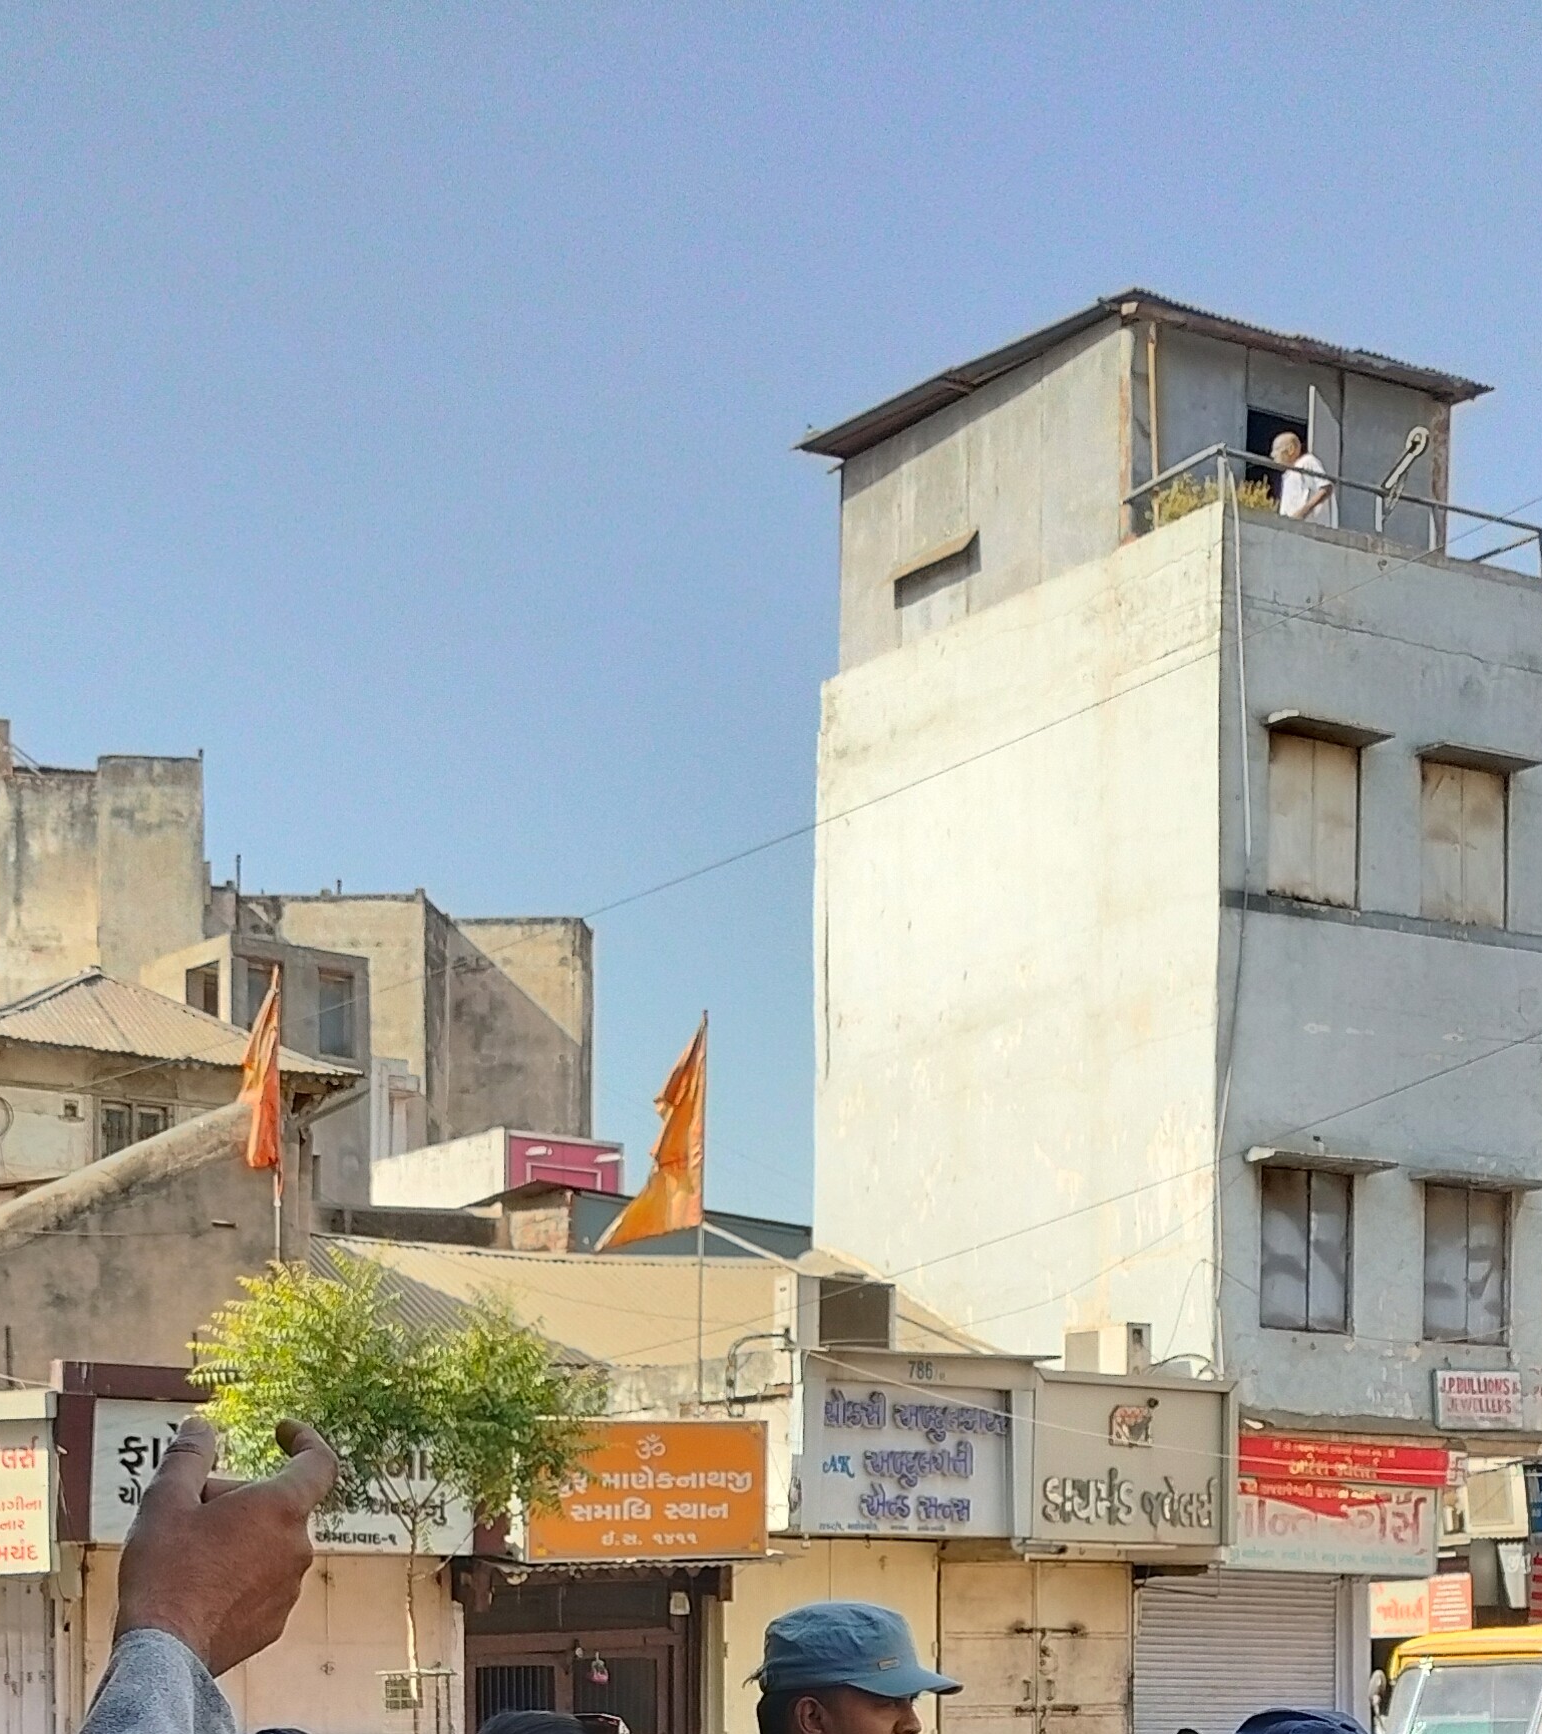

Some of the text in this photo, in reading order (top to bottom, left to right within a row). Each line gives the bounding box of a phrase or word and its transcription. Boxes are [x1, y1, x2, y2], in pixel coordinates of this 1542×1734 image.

[909, 1361, 933, 1379] 786
[1447, 1398, 1512, 1413] JEWELLERS
[822, 1455, 854, 1478] AK
[602, 1466, 752, 1494] માણેકનાથજી
[570, 1497, 729, 1522] સમાધિ સ્થાન
